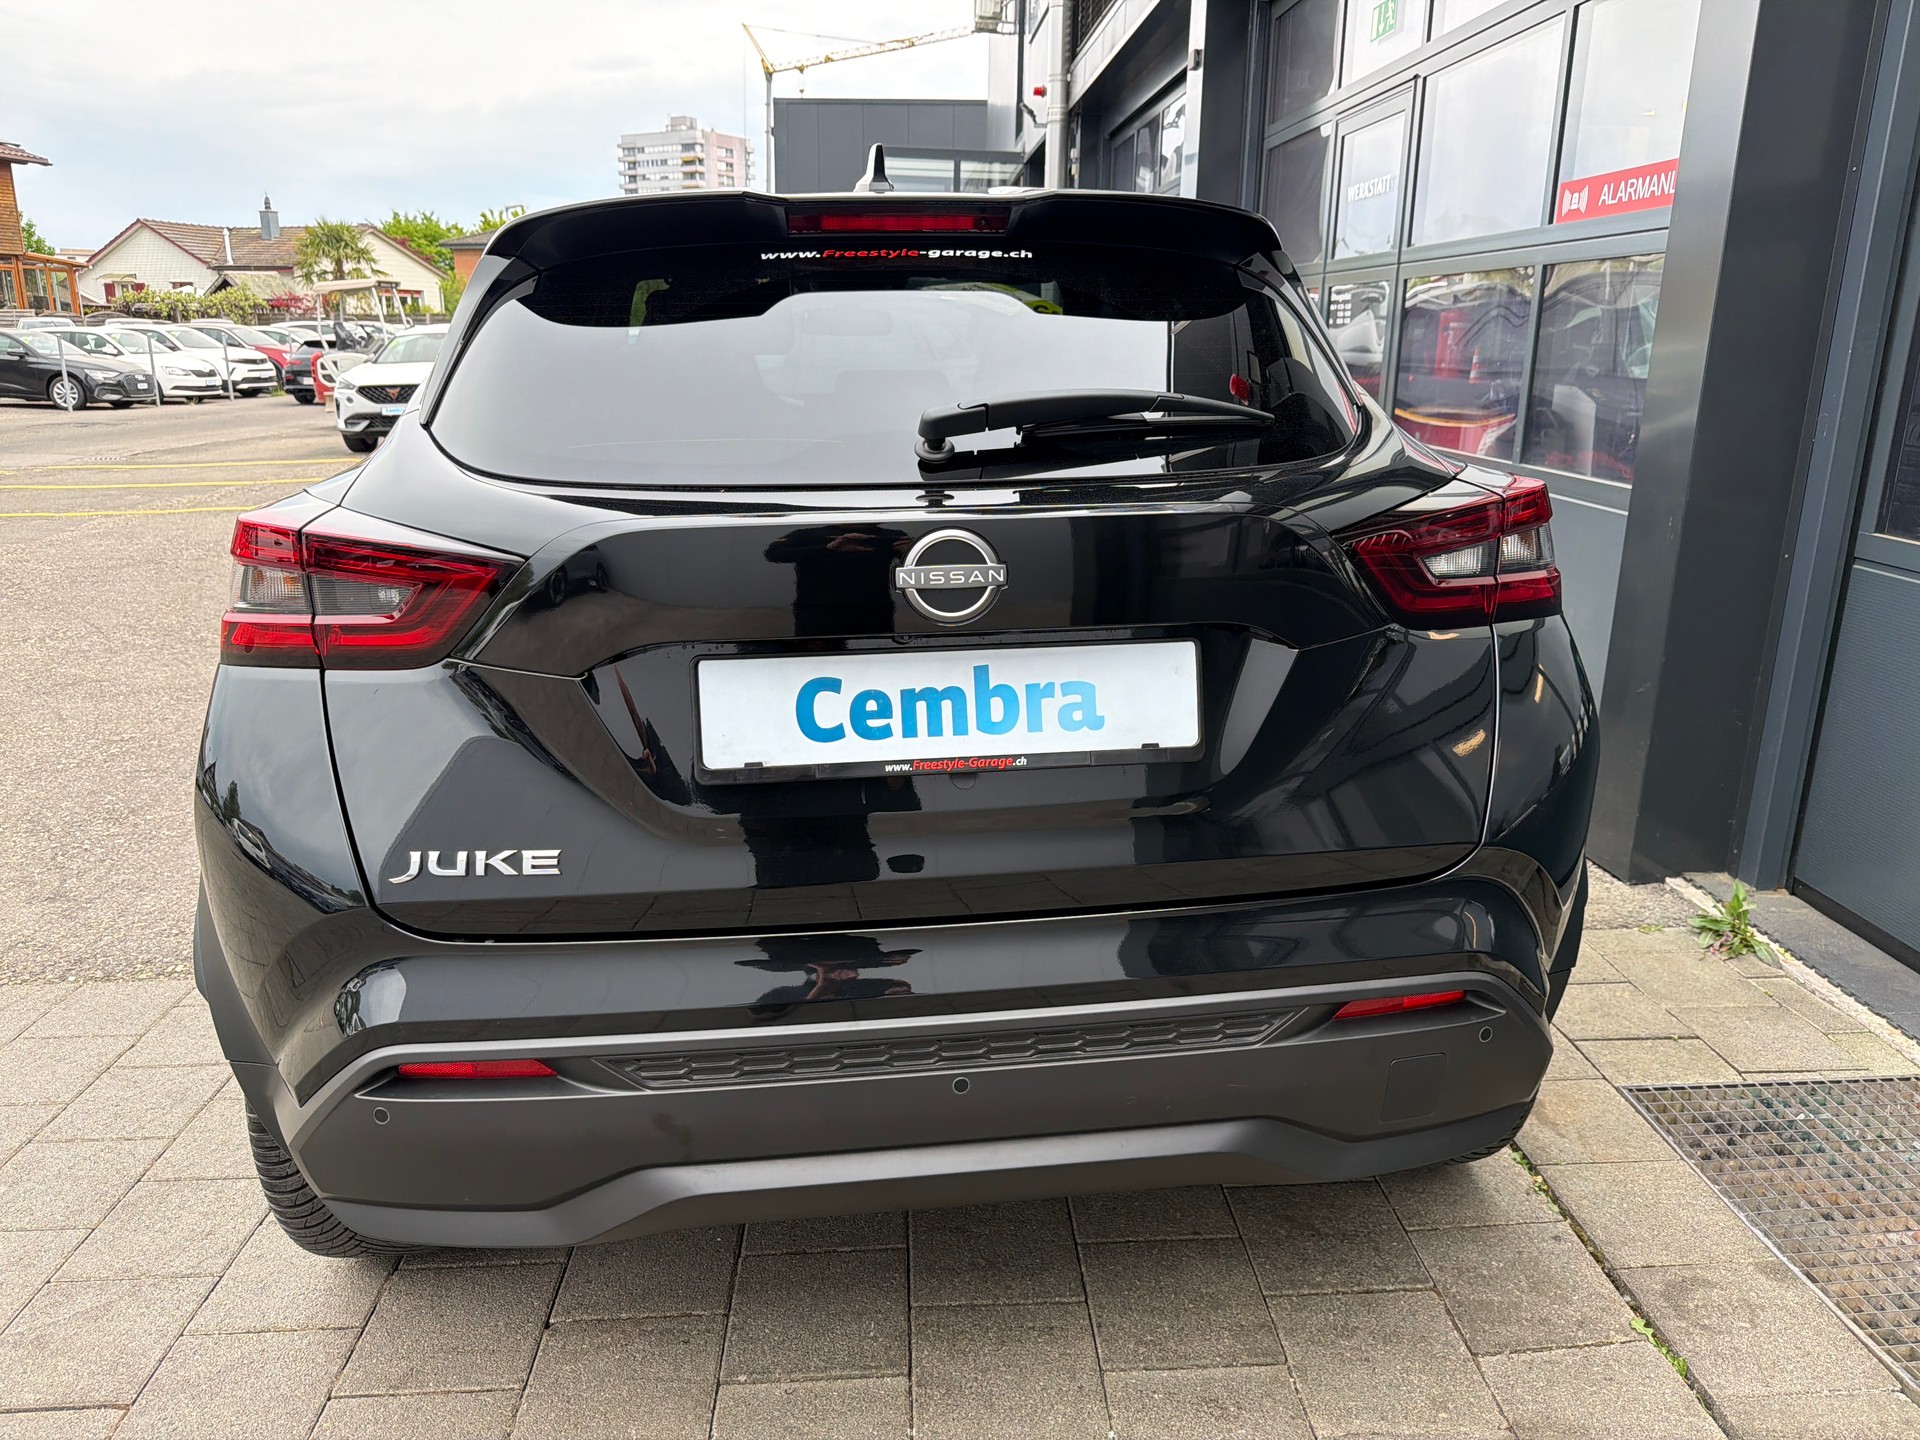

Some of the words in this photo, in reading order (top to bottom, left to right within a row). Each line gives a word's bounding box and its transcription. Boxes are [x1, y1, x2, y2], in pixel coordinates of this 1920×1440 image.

[1347, 174, 1391, 202] WERKSTATT
[761, 248, 1033, 260] www.Freestyle-garage.ch
[899, 569, 1004, 585] NISSAN
[795, 664, 1105, 743] Cembra
[884, 755, 1028, 773] www.Freestyle-Garage.ch
[388, 849, 562, 884] JUKE
